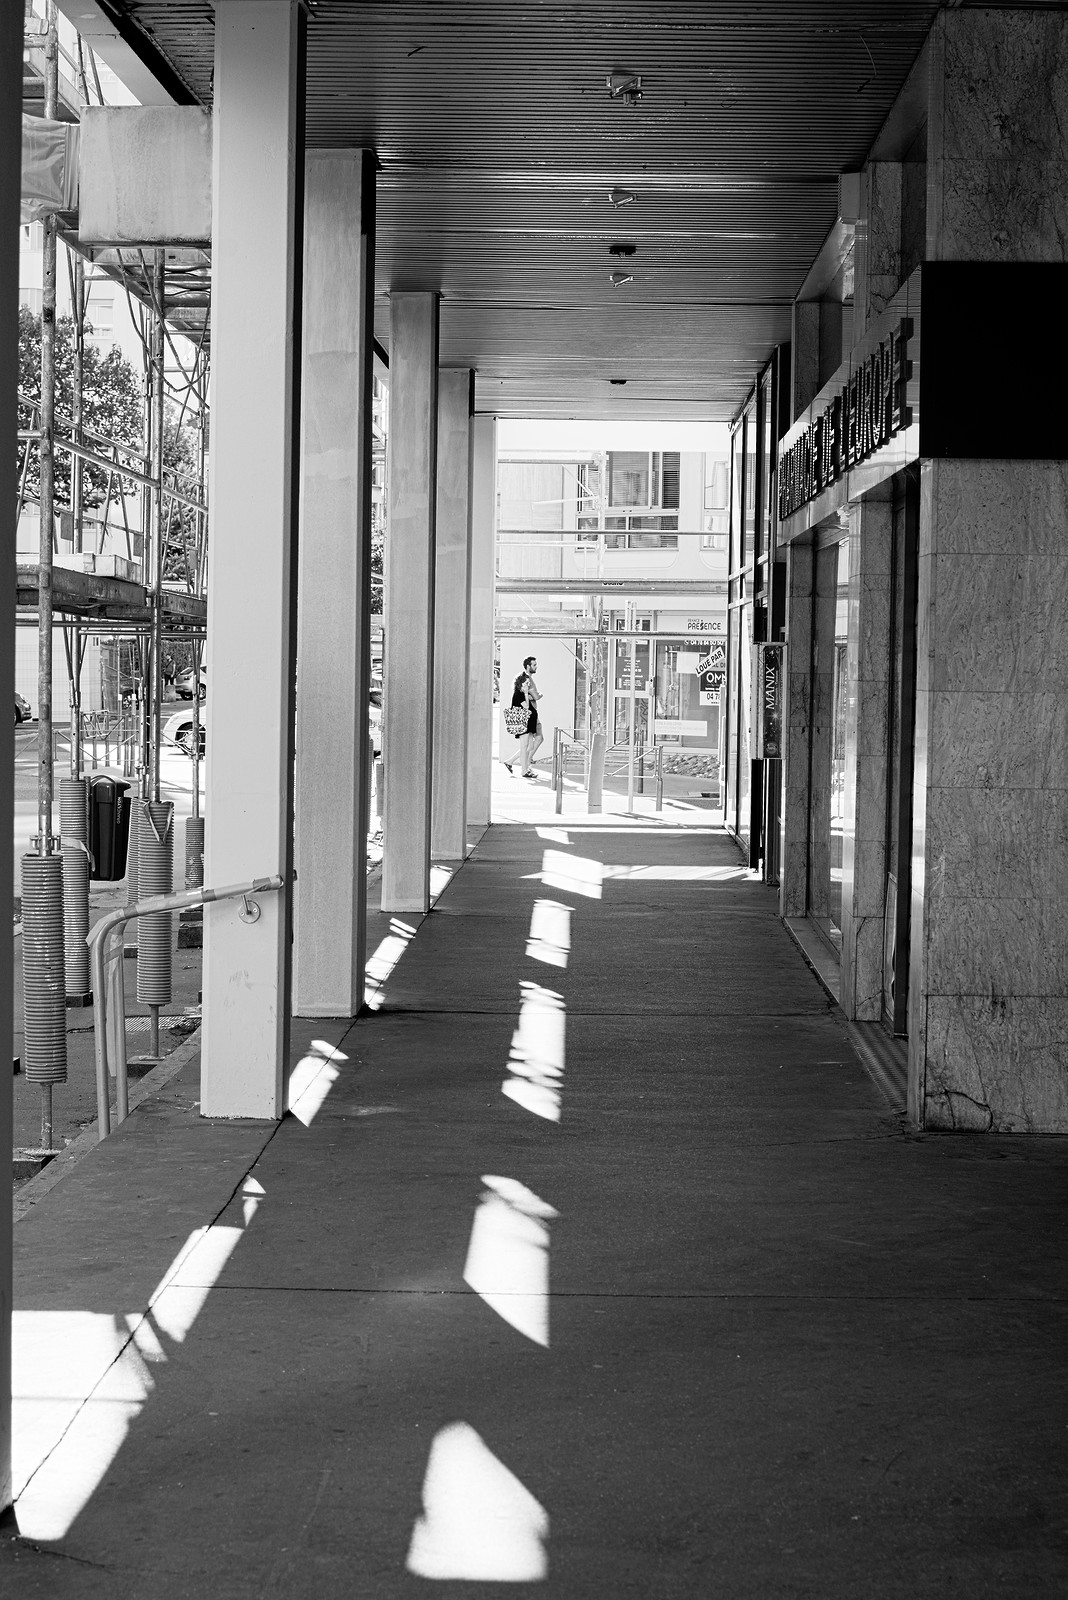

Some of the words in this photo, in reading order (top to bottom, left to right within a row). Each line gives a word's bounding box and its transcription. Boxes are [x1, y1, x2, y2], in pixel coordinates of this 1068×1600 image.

[778, 416, 820, 521] PHARMACIE
[839, 318, 911, 473] L'EUROPE
[711, 650, 723, 664] PAR
[706, 692, 714, 700] 04
[765, 666, 775, 710] MANIX
